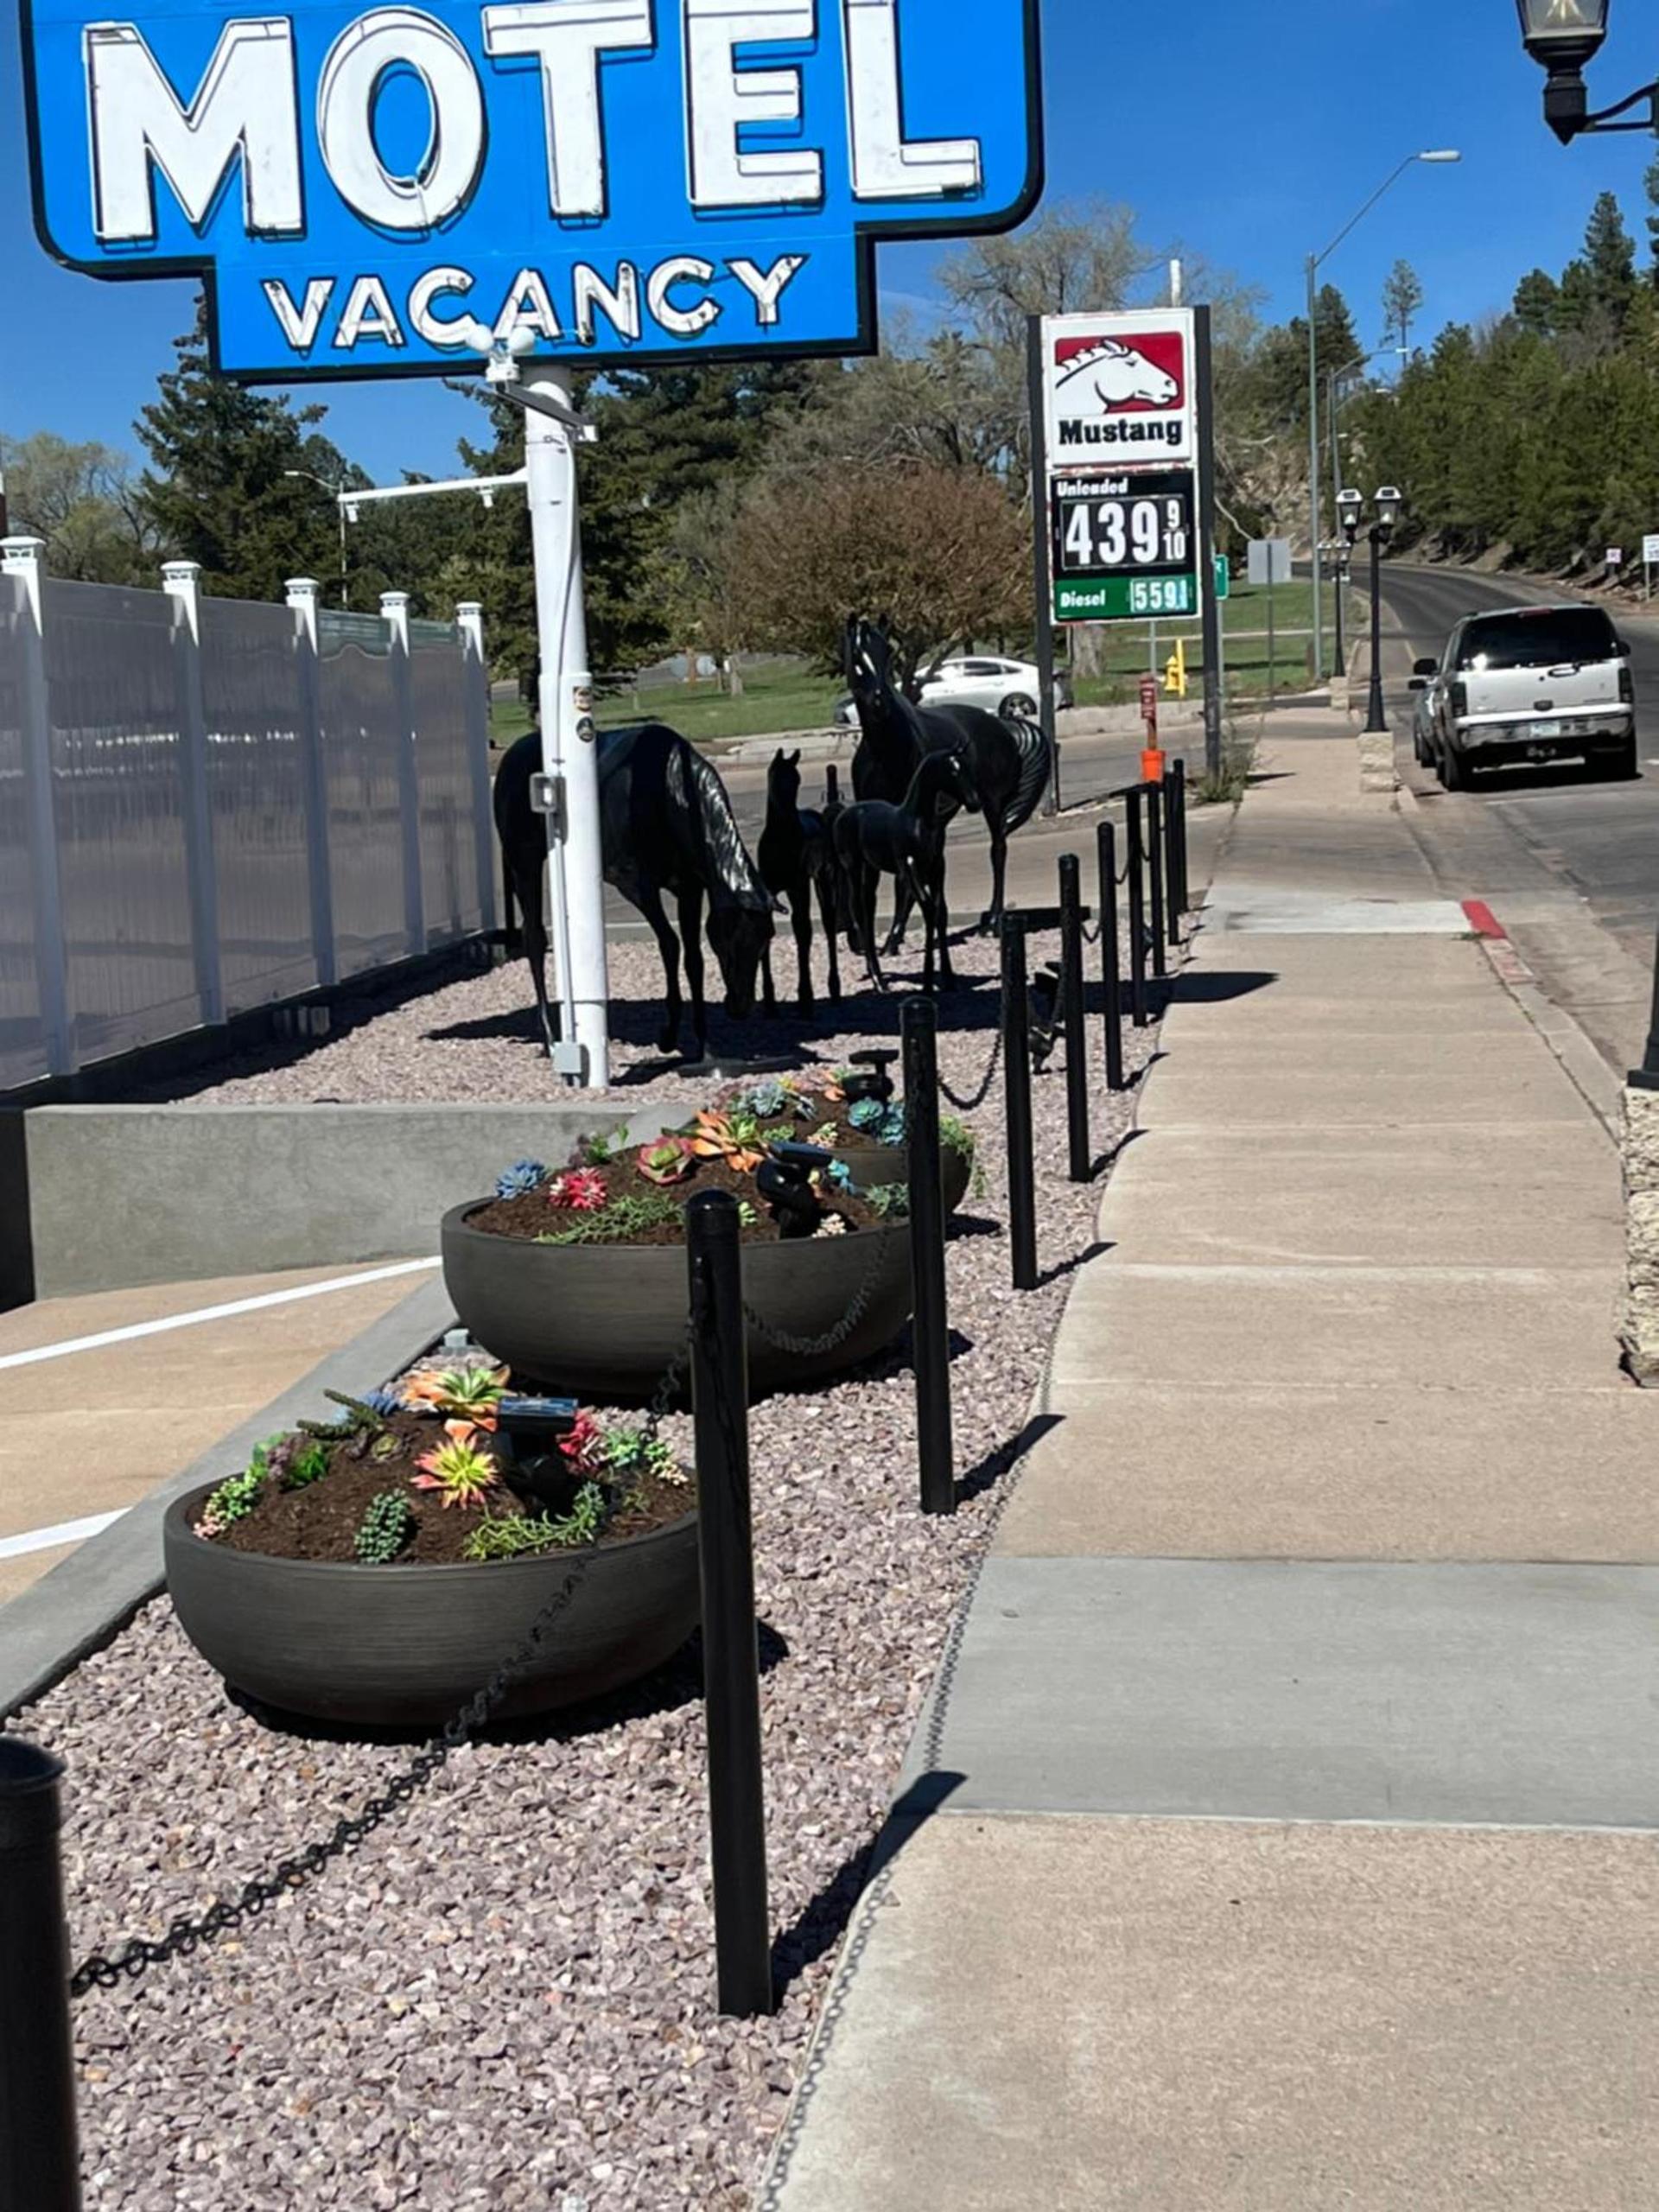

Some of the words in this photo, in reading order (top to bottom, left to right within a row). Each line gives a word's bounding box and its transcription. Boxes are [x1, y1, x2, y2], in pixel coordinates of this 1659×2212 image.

[82, 0, 982, 242] MOTEL
[263, 254, 809, 348] VACANCY
[1058, 419, 1183, 446] Mustang
[1057, 477, 1128, 497] Unleaded
[1065, 501, 1159, 564] 439
[1060, 590, 1105, 607] Diesel
